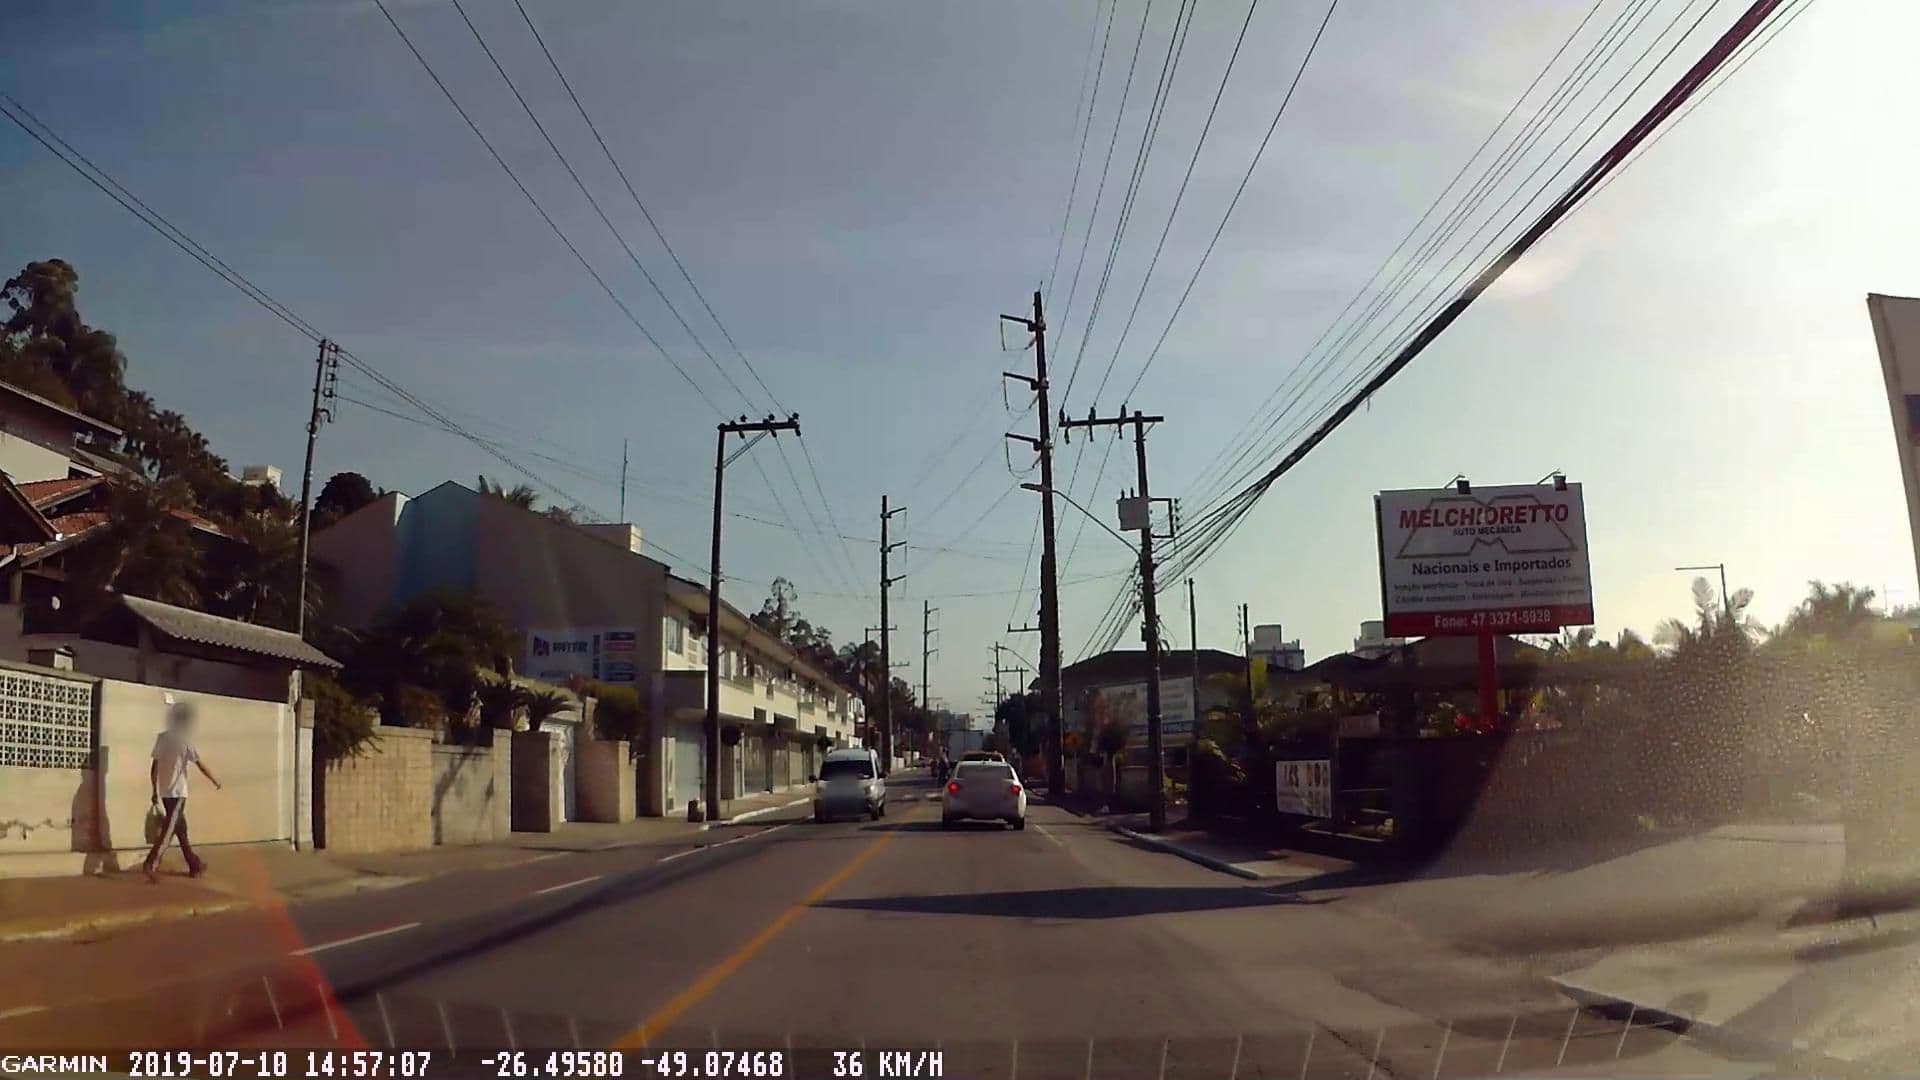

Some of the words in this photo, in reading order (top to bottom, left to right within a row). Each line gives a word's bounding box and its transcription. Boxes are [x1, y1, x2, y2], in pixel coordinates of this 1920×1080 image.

[1400, 504, 1569, 529] MELCHIORETTO
[1412, 562, 1479, 575] Nacionais
[1483, 563, 1490, 571] e
[1495, 556, 1571, 574] Importados
[1434, 614, 1468, 628] Fone:
[1471, 612, 1486, 626] 47
